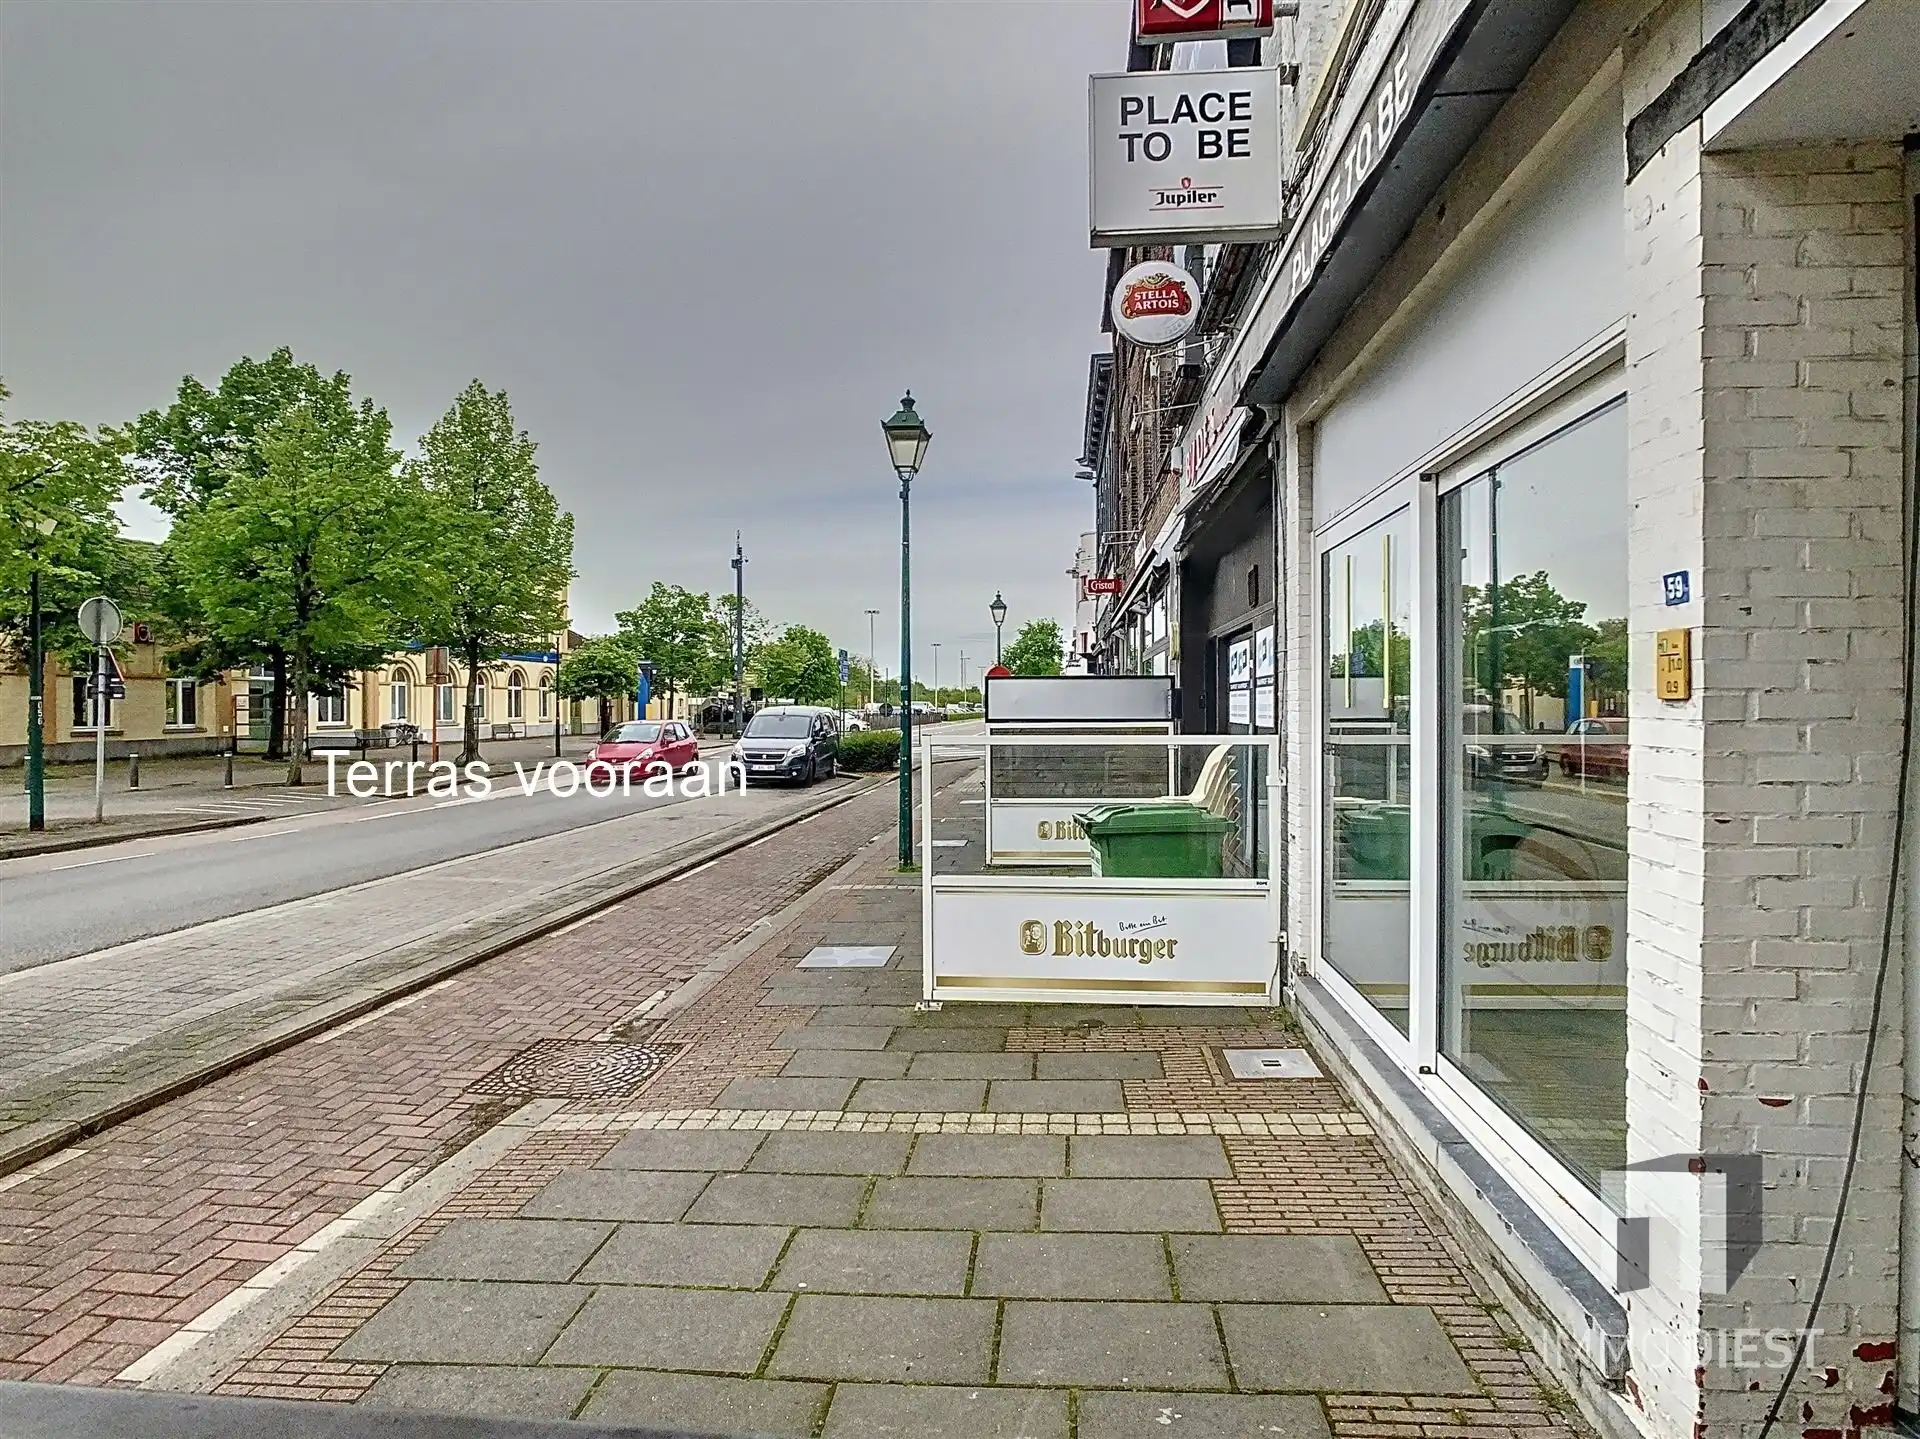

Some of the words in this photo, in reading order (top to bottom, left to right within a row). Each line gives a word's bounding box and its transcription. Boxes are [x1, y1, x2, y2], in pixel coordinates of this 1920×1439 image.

[1120, 91, 1252, 126] PLACE
[1118, 132, 1172, 162] TO
[1198, 128, 1251, 159] BE
[1291, 173, 1341, 297] PLACE
[1345, 121, 1372, 201] TO
[1377, 43, 1409, 151] BE
[1155, 190, 1217, 207] Jupiler
[1134, 289, 1178, 301] STELLA
[1134, 299, 1179, 311] ARTOIS
[1090, 580, 1115, 591] Cristal
[1667, 575, 1684, 601] 59
[1052, 919, 1179, 965] Bitburger
